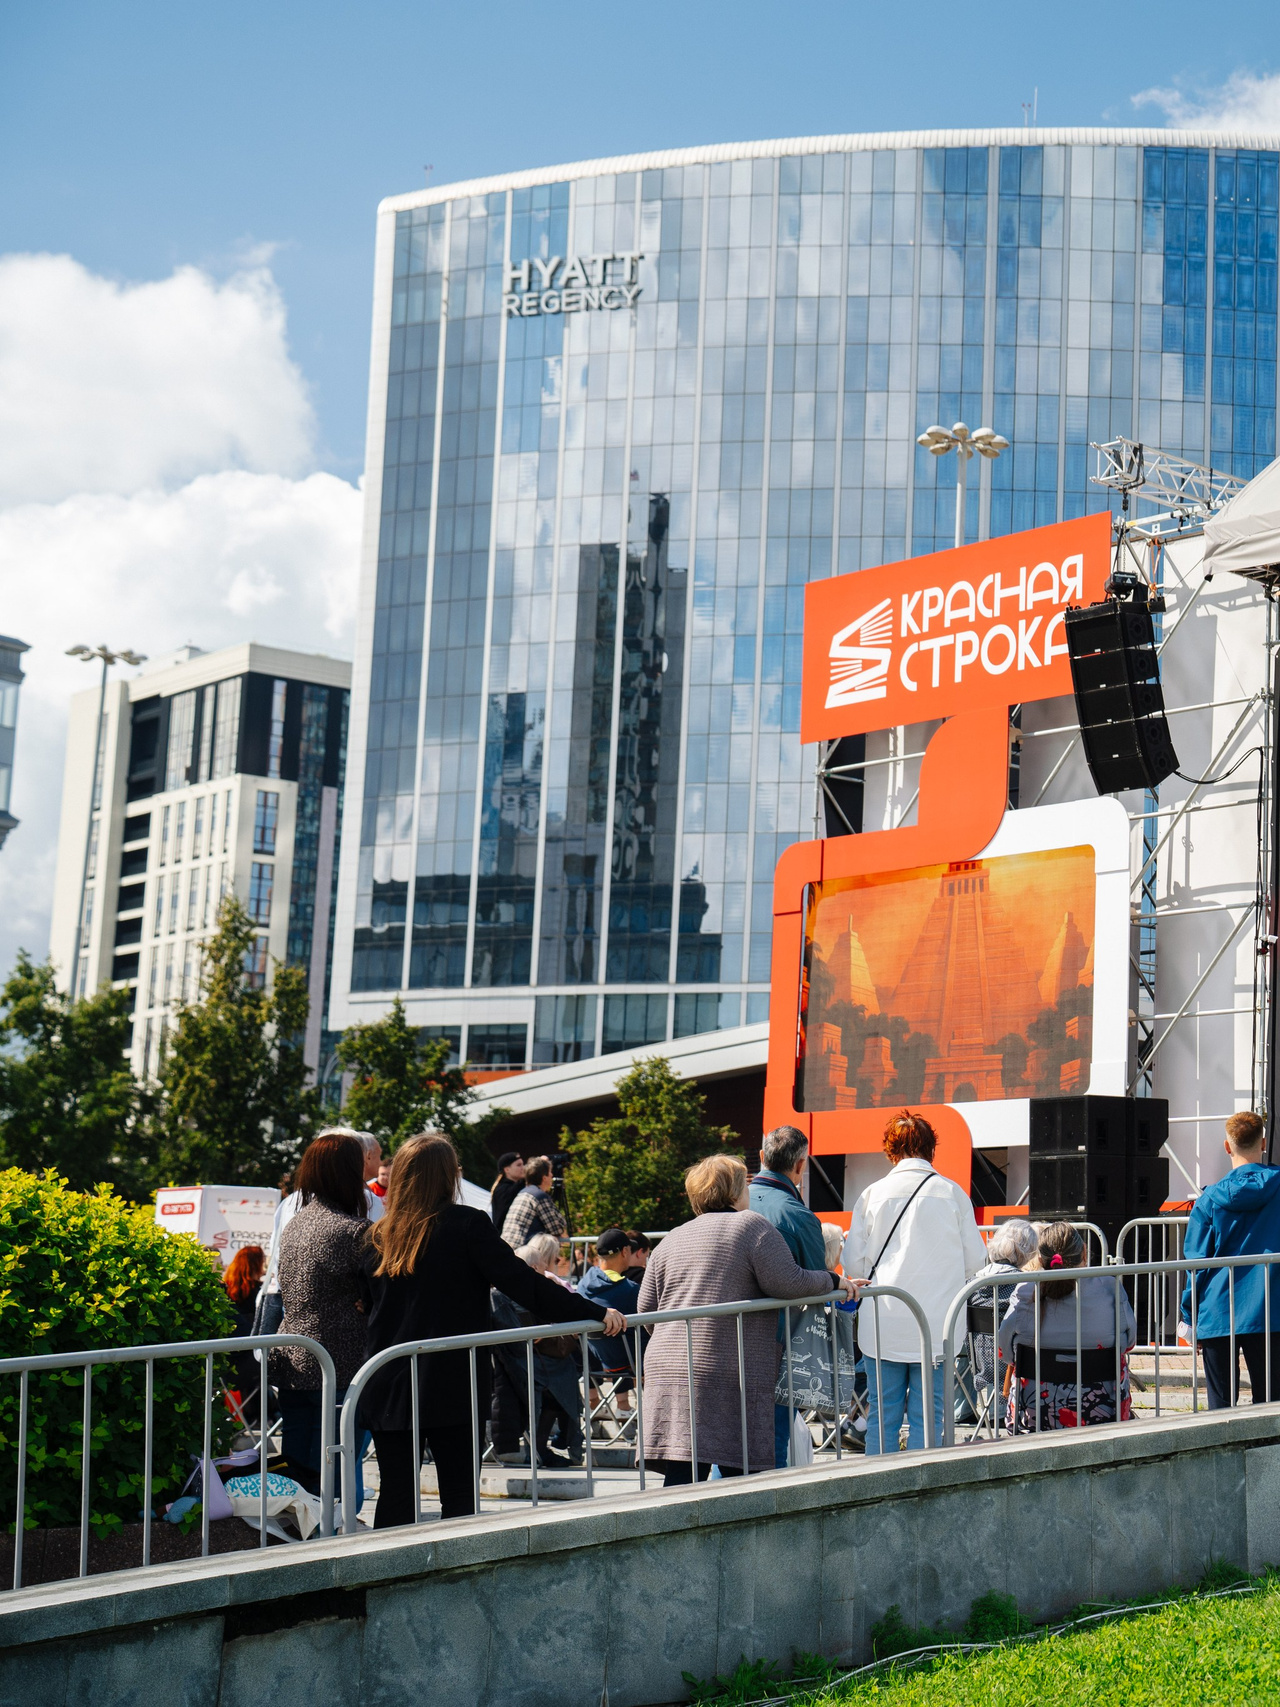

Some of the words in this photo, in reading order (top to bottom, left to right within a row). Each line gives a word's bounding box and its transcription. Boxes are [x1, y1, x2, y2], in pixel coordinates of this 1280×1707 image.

[503, 252, 641, 293] HYATT
[504, 284, 641, 316] REGENCY
[901, 553, 1084, 638] КРАСНАЯ
[900, 611, 1069, 692] СТРОКА
